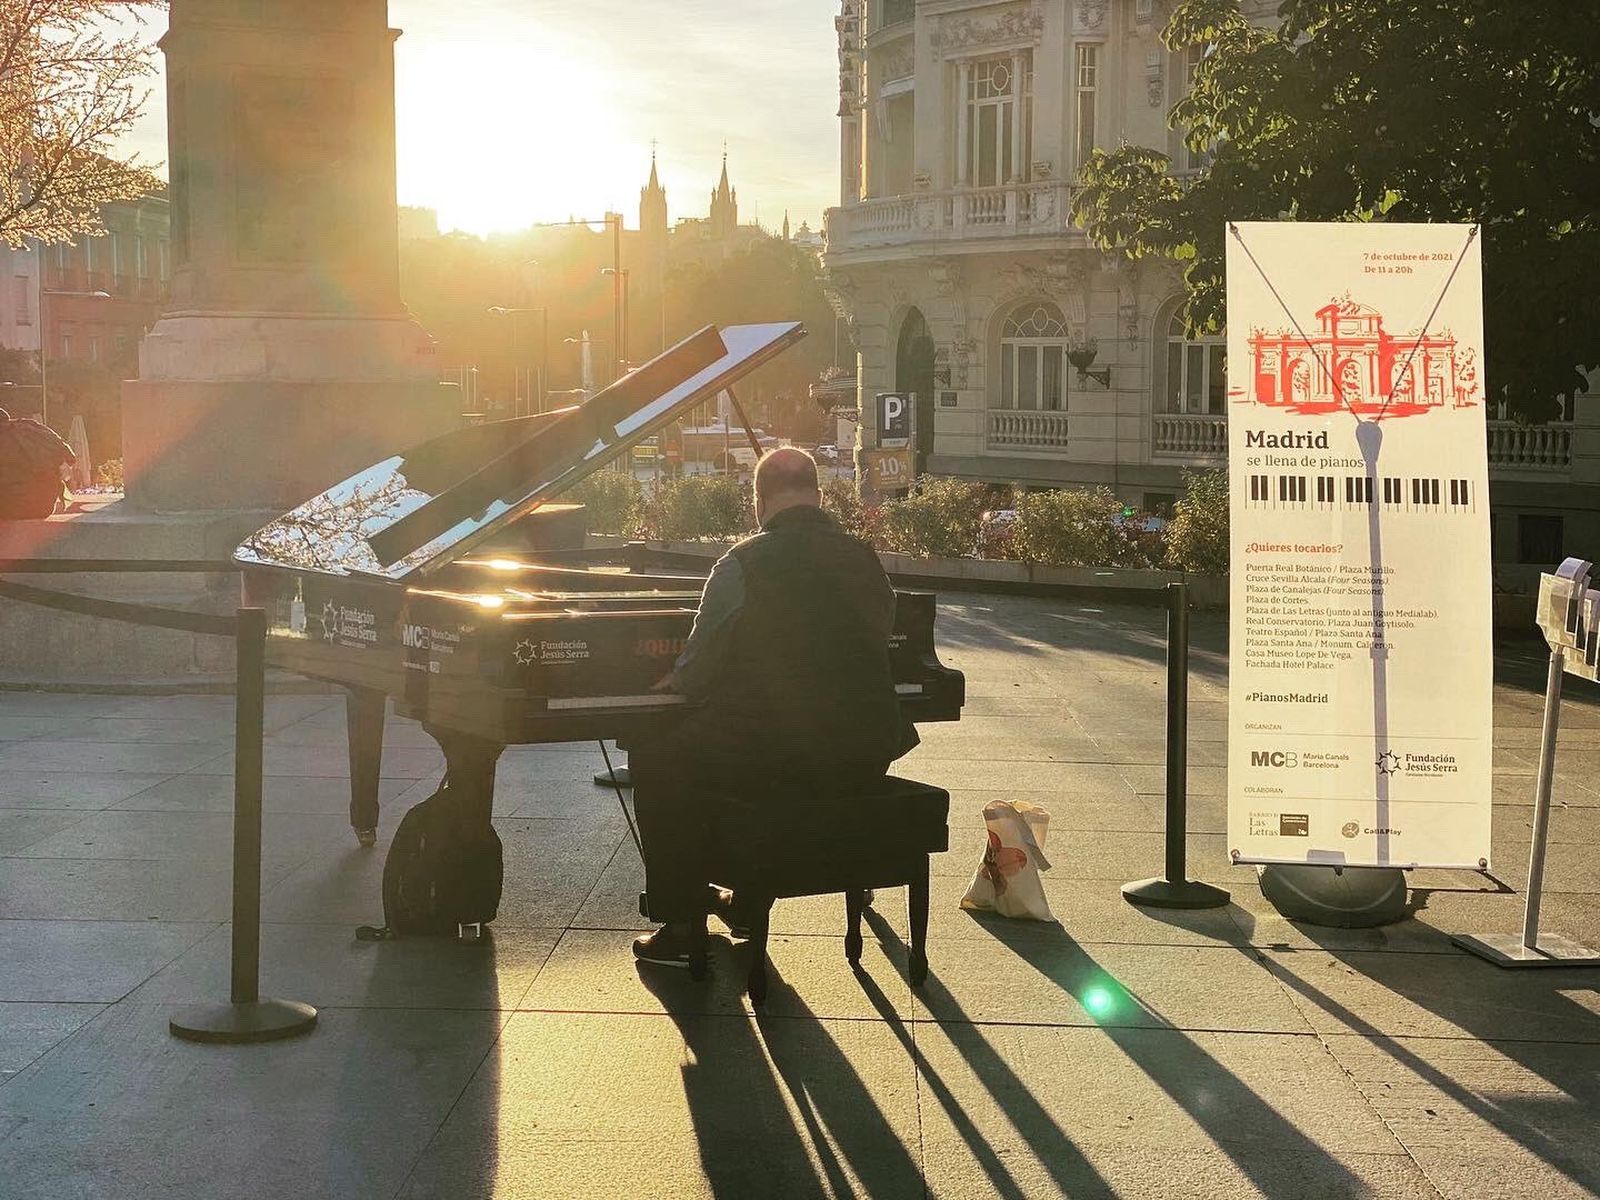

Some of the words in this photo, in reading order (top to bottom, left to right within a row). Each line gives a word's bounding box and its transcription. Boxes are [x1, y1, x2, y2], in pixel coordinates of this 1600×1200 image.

[1395, 266, 1413, 274] 20h
[885, 396, 902, 430] P
[1245, 430, 1329, 449] Madrid
[1247, 458, 1261, 466] se
[1265, 455, 1297, 467] llena
[1301, 456, 1316, 467] de
[1320, 457, 1364, 469] pianos
[1245, 542, 1292, 554] ¿Quieres
[1294, 543, 1343, 554] tocarlos?
[1246, 564, 1273, 572] Puerta
[1275, 564, 1294, 572] Real
[1296, 564, 1332, 573] Botánico
[1328, 576, 1349, 584] (Four
[1282, 586, 1321, 594] Canalejas
[1323, 586, 1346, 594] (Four
[1326, 608, 1351, 616] (junto
[1274, 628, 1307, 637] Español
[541, 640, 587, 650] Fundación
[566, 650, 589, 658] Serra
[1296, 650, 1316, 659] Lope
[1246, 692, 1328, 703] #PianosMadrid
[1251, 751, 1298, 768] MCB
[1406, 753, 1455, 763] Fundación
[1405, 763, 1431, 771] Jesús
[1433, 763, 1458, 772] Serra
[1249, 818, 1265, 826] Las
[1249, 827, 1279, 836] Letras
